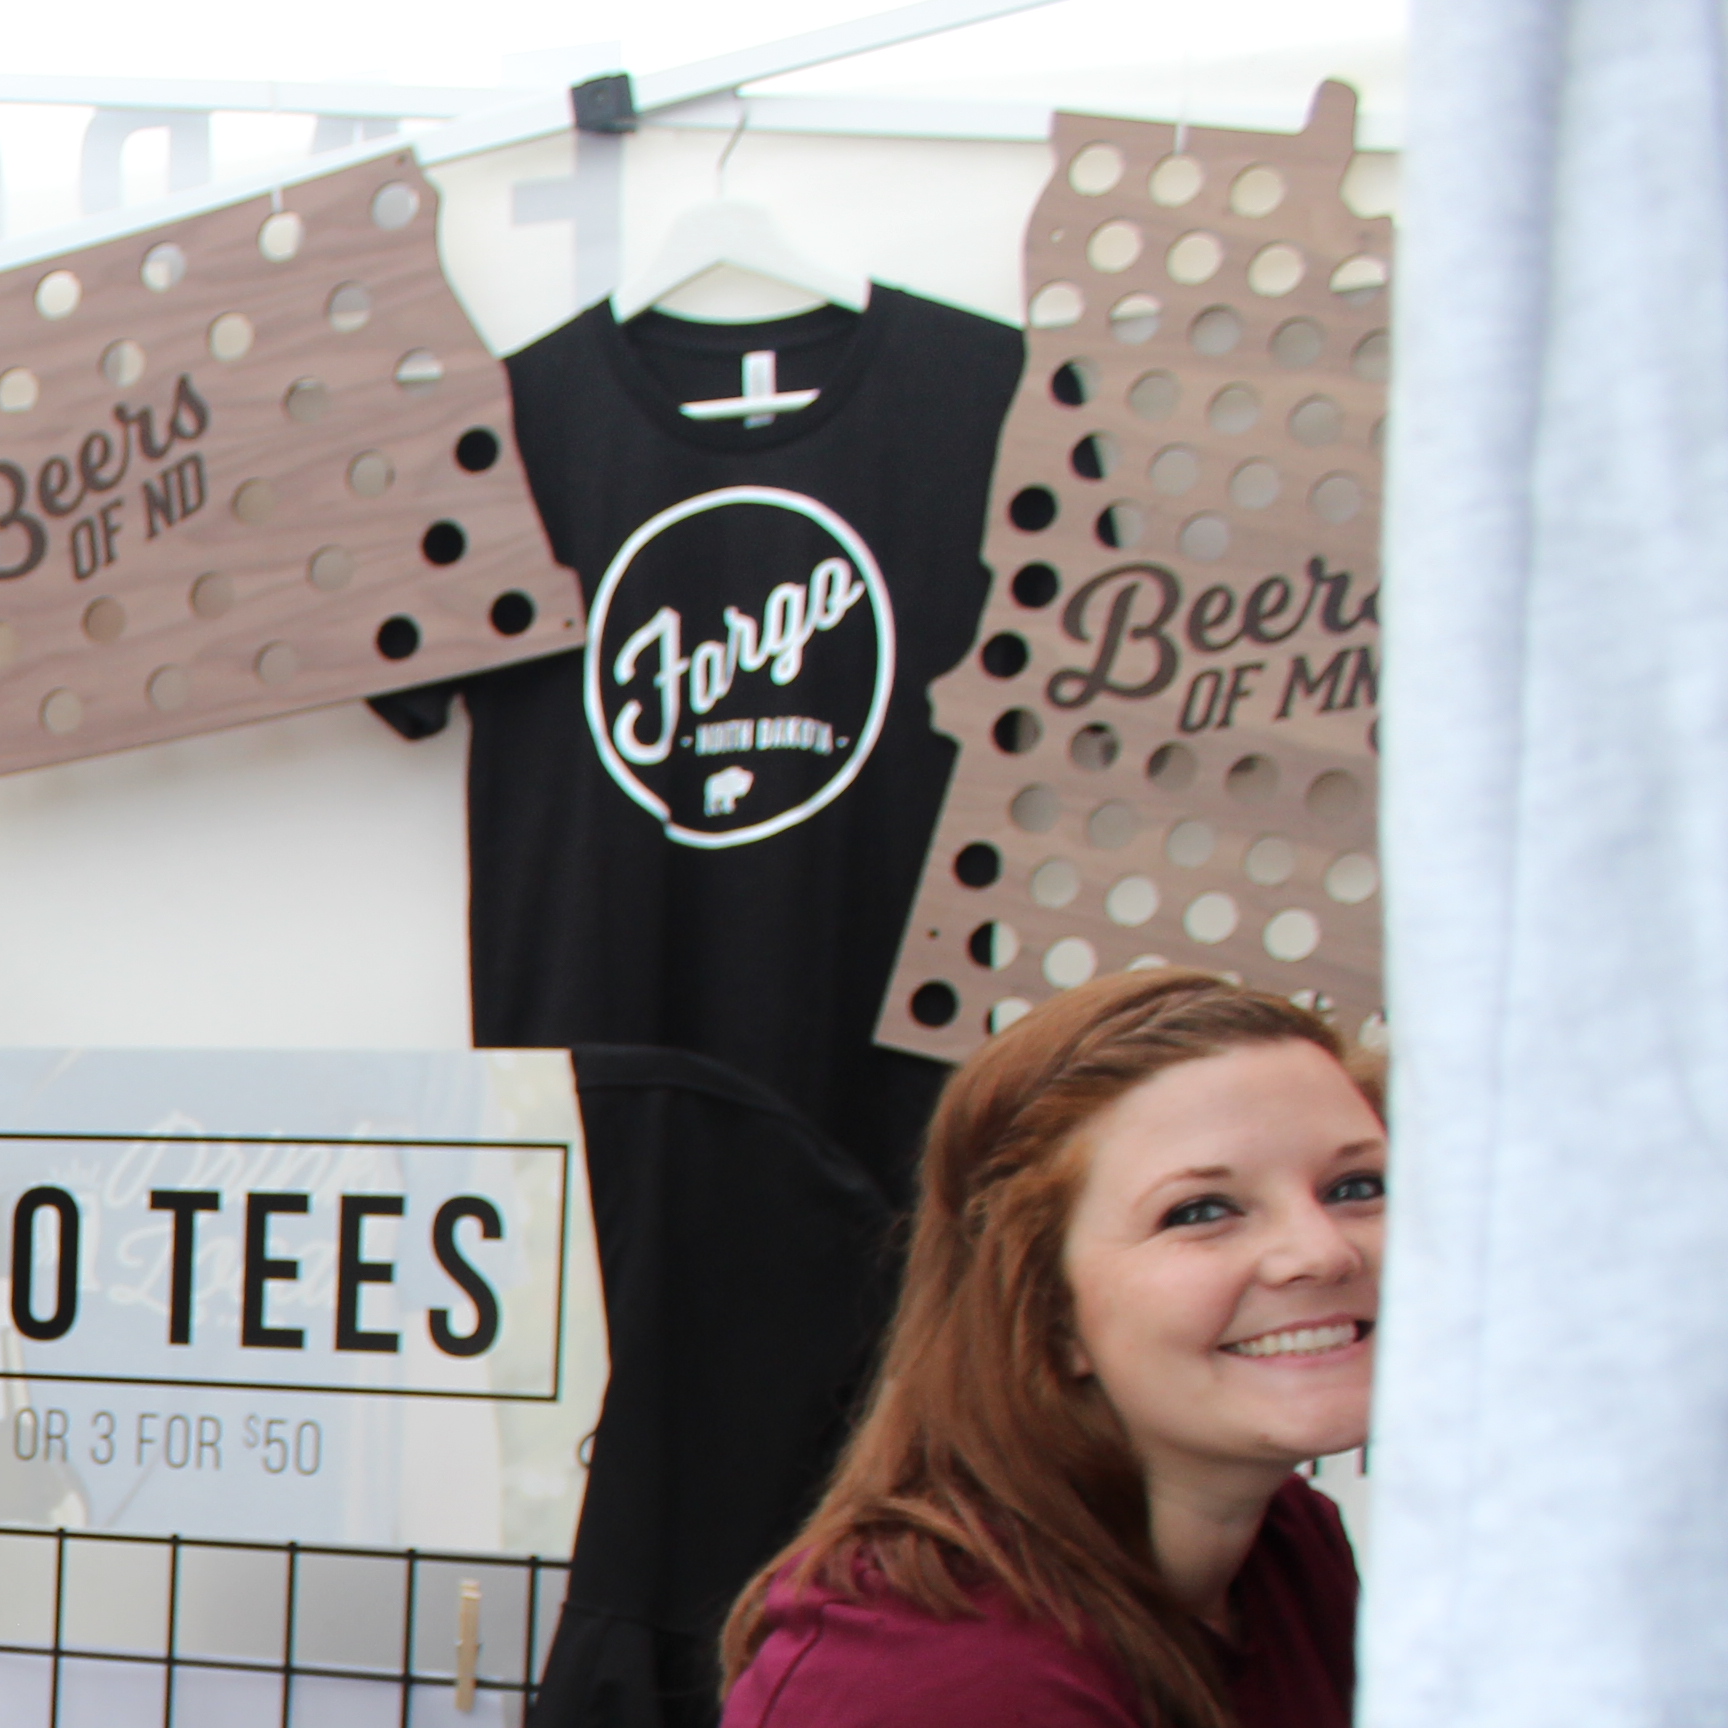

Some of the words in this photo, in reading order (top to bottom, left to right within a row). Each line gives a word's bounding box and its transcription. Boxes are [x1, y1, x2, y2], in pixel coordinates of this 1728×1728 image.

[68, 499, 123, 582] OF
[144, 453, 208, 541] ND
[613, 557, 866, 766] Fargo
[1046, 554, 1380, 710] Beer
[1177, 662, 1264, 734] OF
[149, 1187, 505, 1358] TEES
[13, 1408, 70, 1464] OR
[91, 1412, 117, 1467] 3
[136, 1414, 223, 1470] FOR
[243, 1414, 324, 1477] $50
